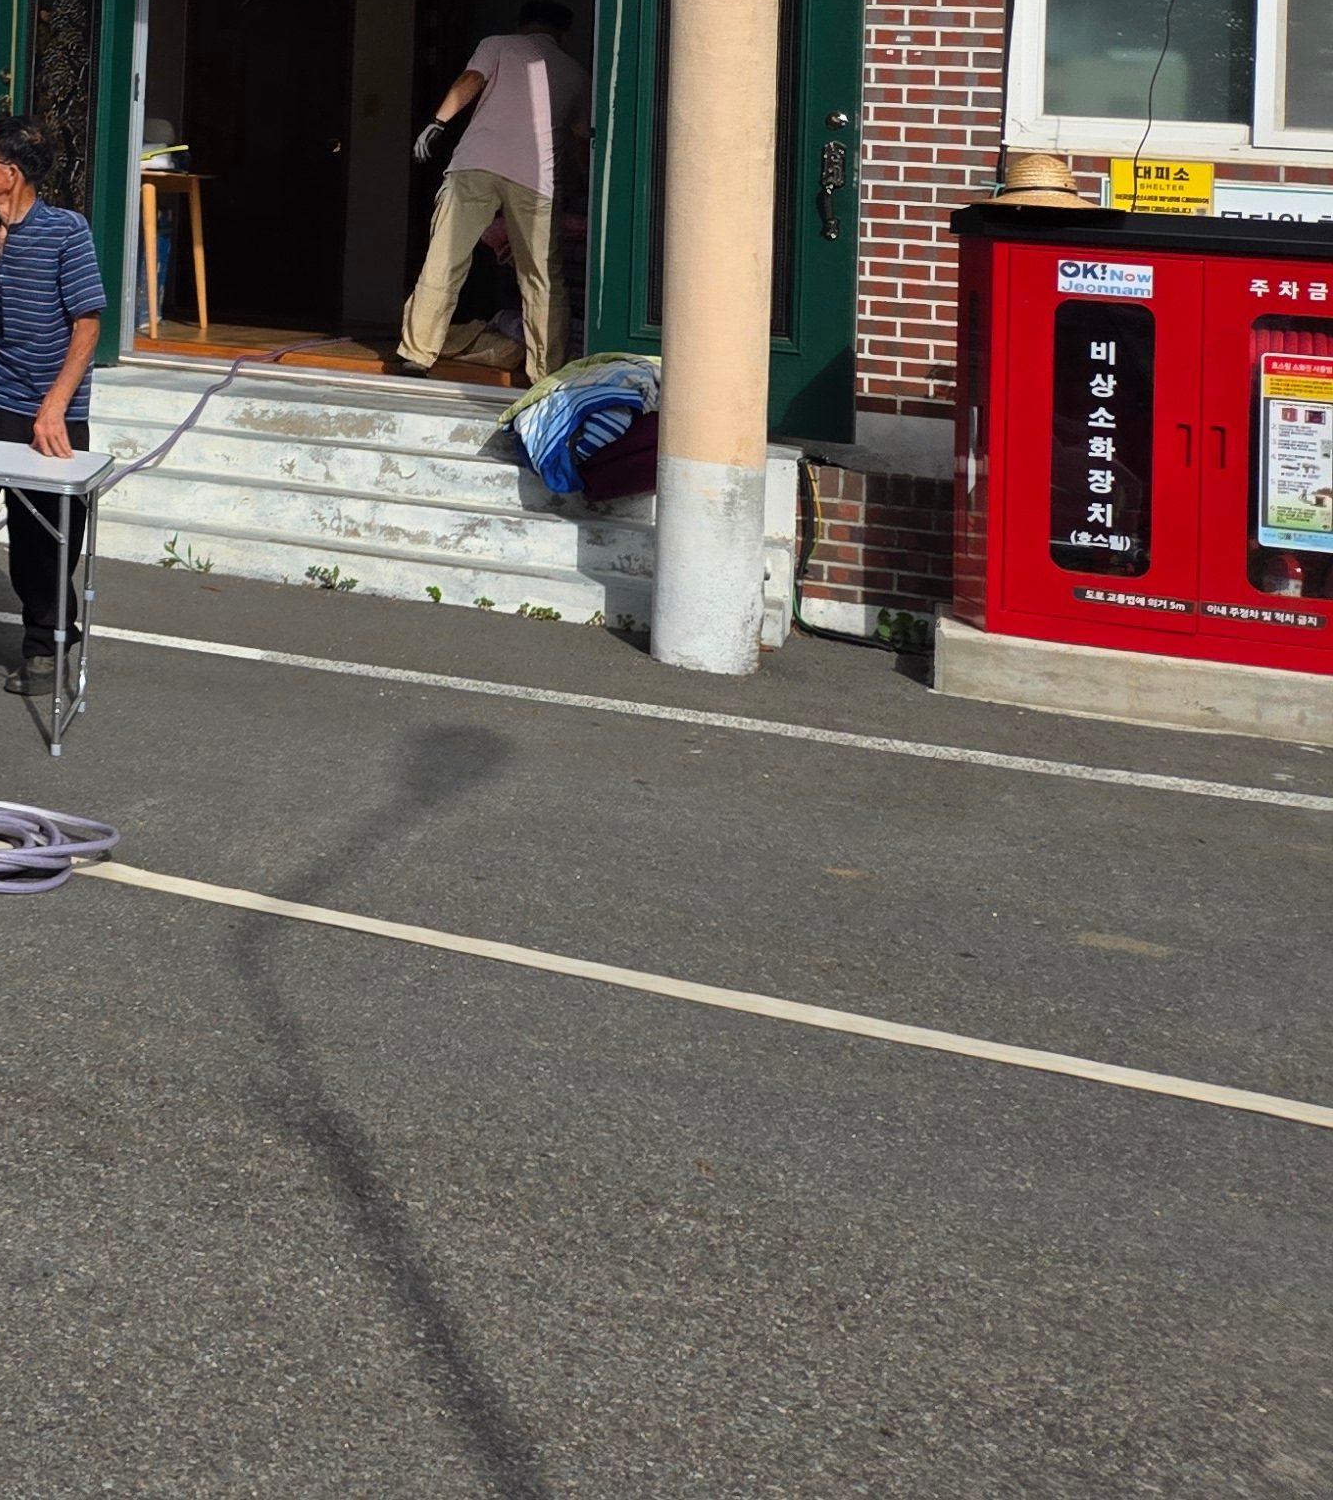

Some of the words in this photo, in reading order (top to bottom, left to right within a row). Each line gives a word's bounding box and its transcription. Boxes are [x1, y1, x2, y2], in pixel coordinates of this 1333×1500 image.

[1136, 165, 1190, 181] 대피소
[1139, 183, 1184, 192] SHELTER
[1061, 279, 1151, 297] Jeonnam
[1169, 601, 1186, 611] 5m
[1206, 604, 1227, 616] 이내
